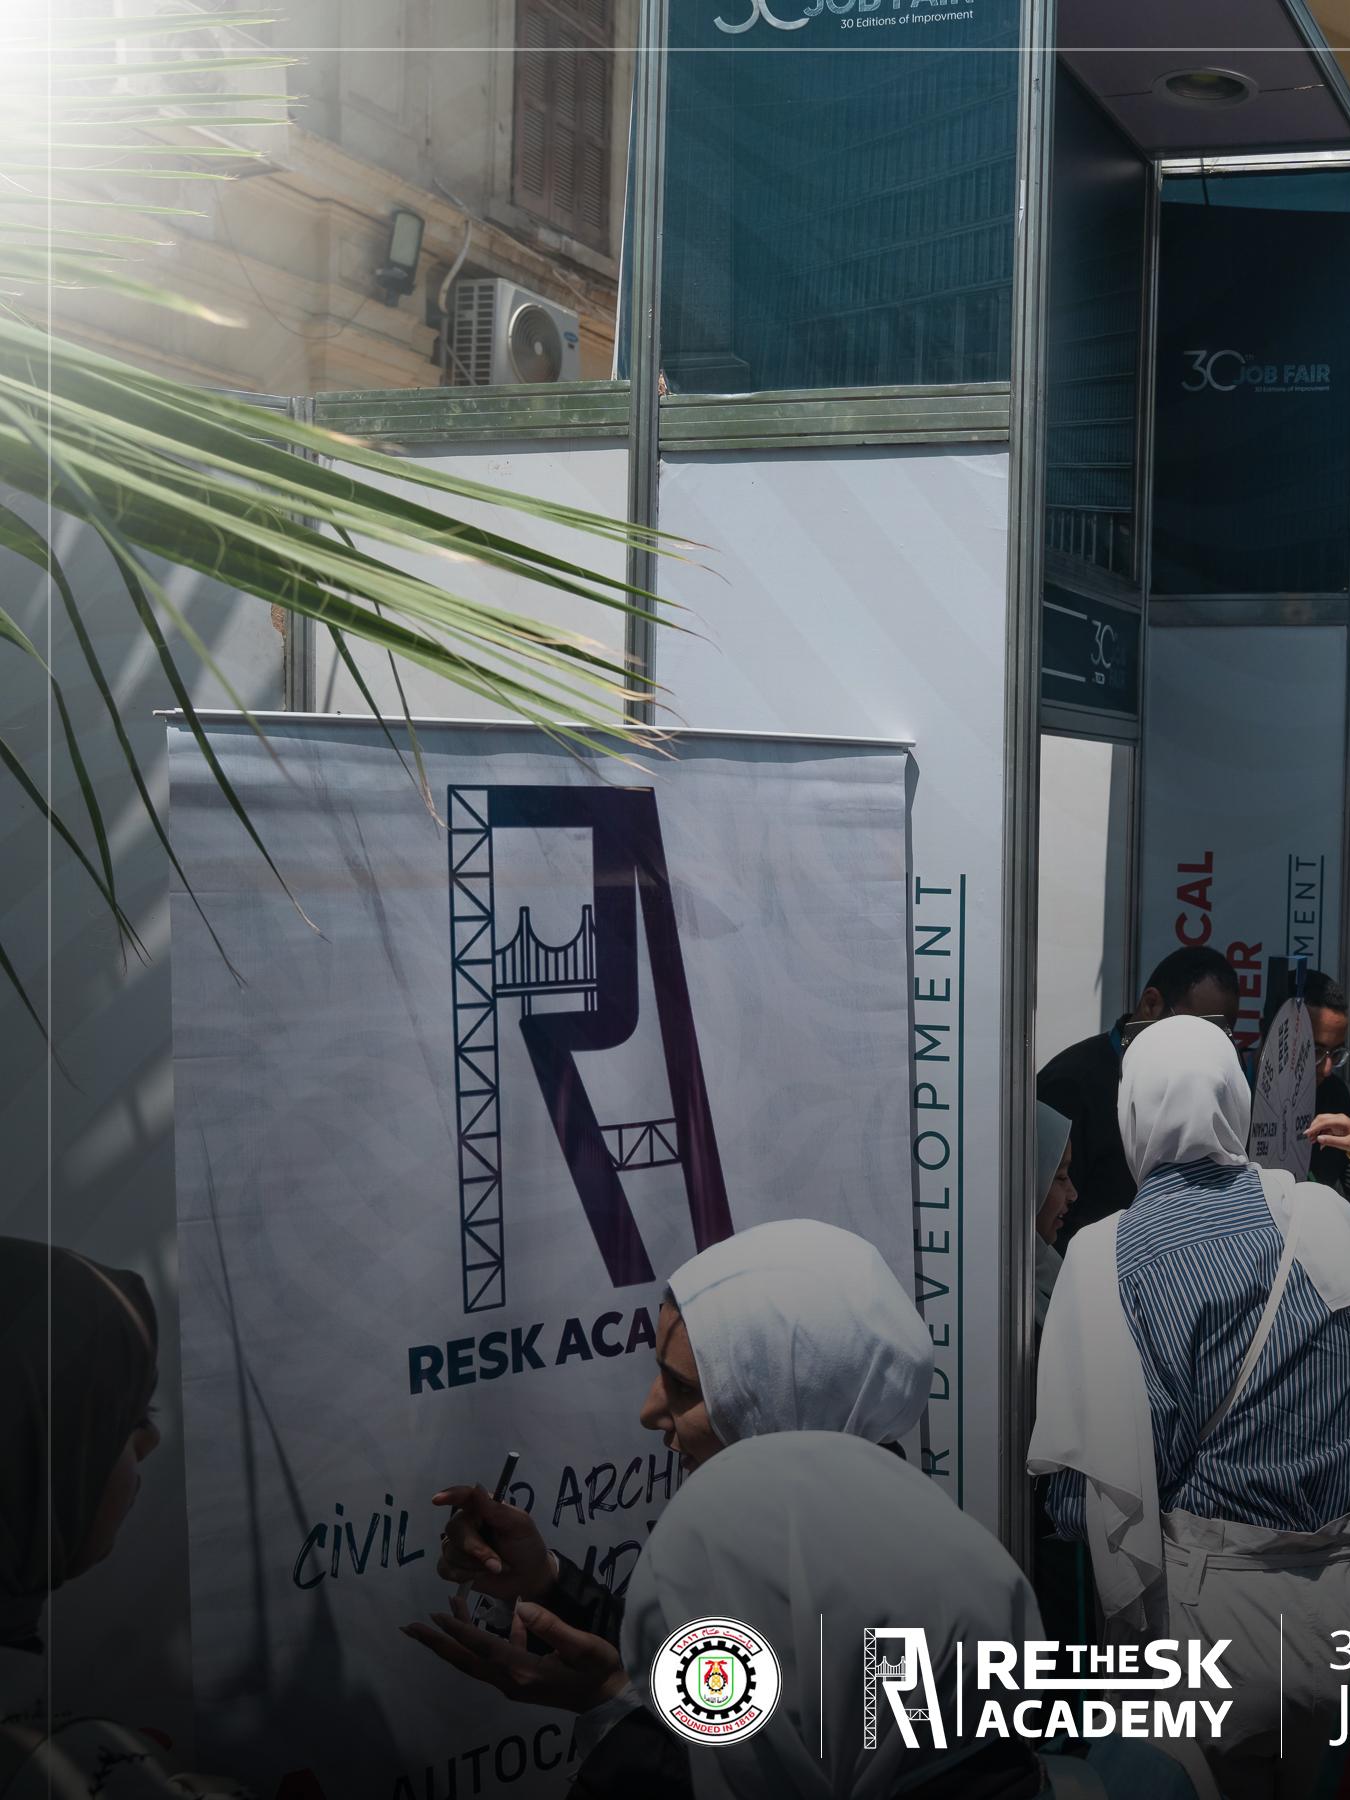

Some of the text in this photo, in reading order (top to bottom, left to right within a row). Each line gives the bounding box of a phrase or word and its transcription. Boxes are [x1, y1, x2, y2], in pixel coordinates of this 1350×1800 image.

[840, 10, 974, 29] 30 Editions of Improvment
[1232, 363, 1331, 385] JOB FAIR
[1294, 855, 1317, 956] MENT
[912, 874, 953, 1401] DEVELOPMENT
[408, 1306, 658, 1396] RESK ACA
[392, 1722, 580, 1800] AUTOC
